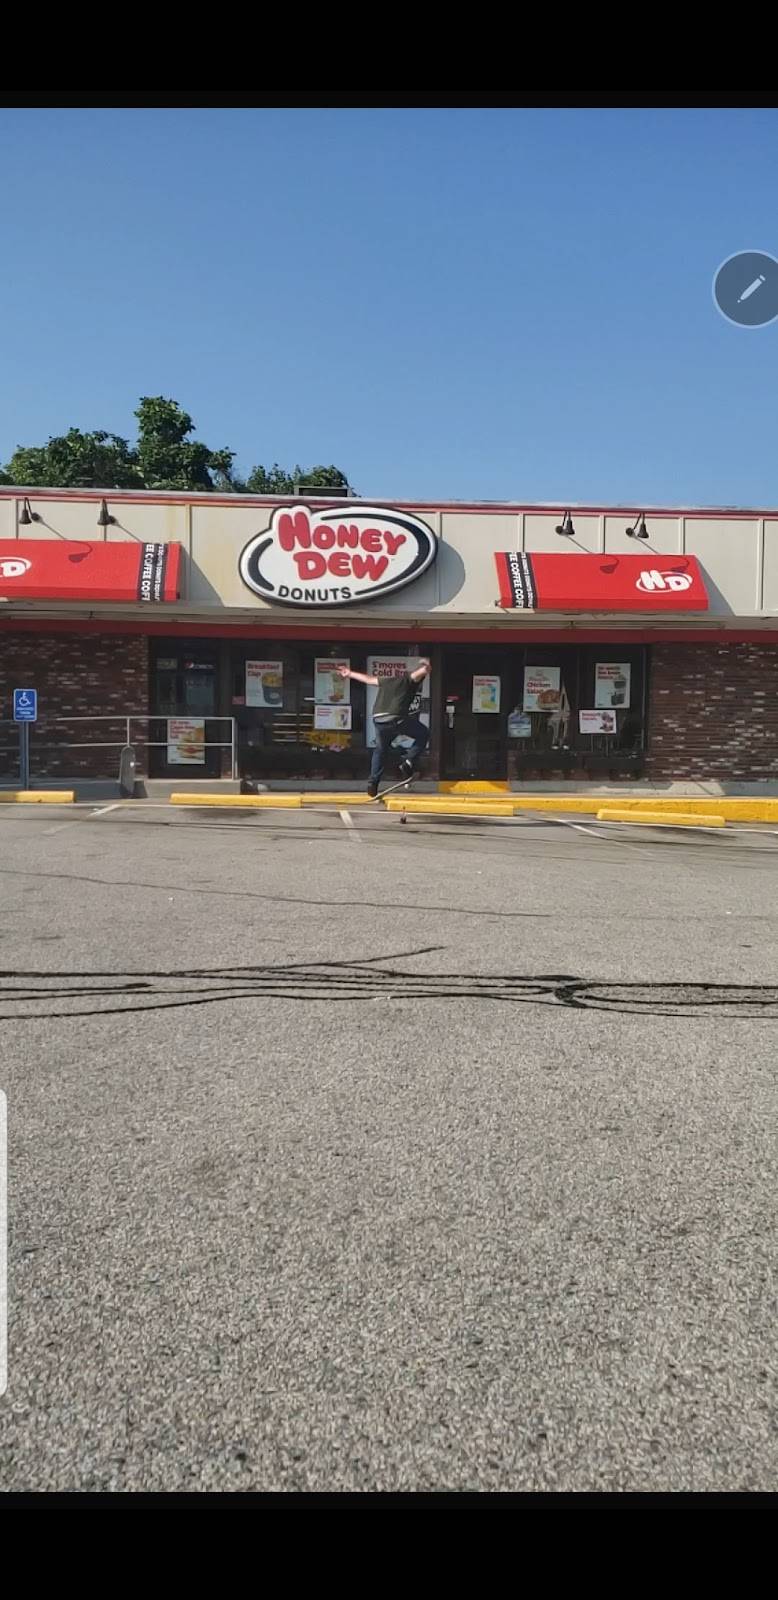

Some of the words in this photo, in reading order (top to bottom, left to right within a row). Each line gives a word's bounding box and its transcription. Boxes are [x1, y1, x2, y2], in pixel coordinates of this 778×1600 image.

[278, 511, 407, 555] HONEY
[142, 553, 153, 579] COFFEE
[293, 551, 389, 581] DEW
[510, 562, 522, 588] COFFEE
[278, 585, 352, 601] DONUTS
[372, 669, 393, 677] Cold
